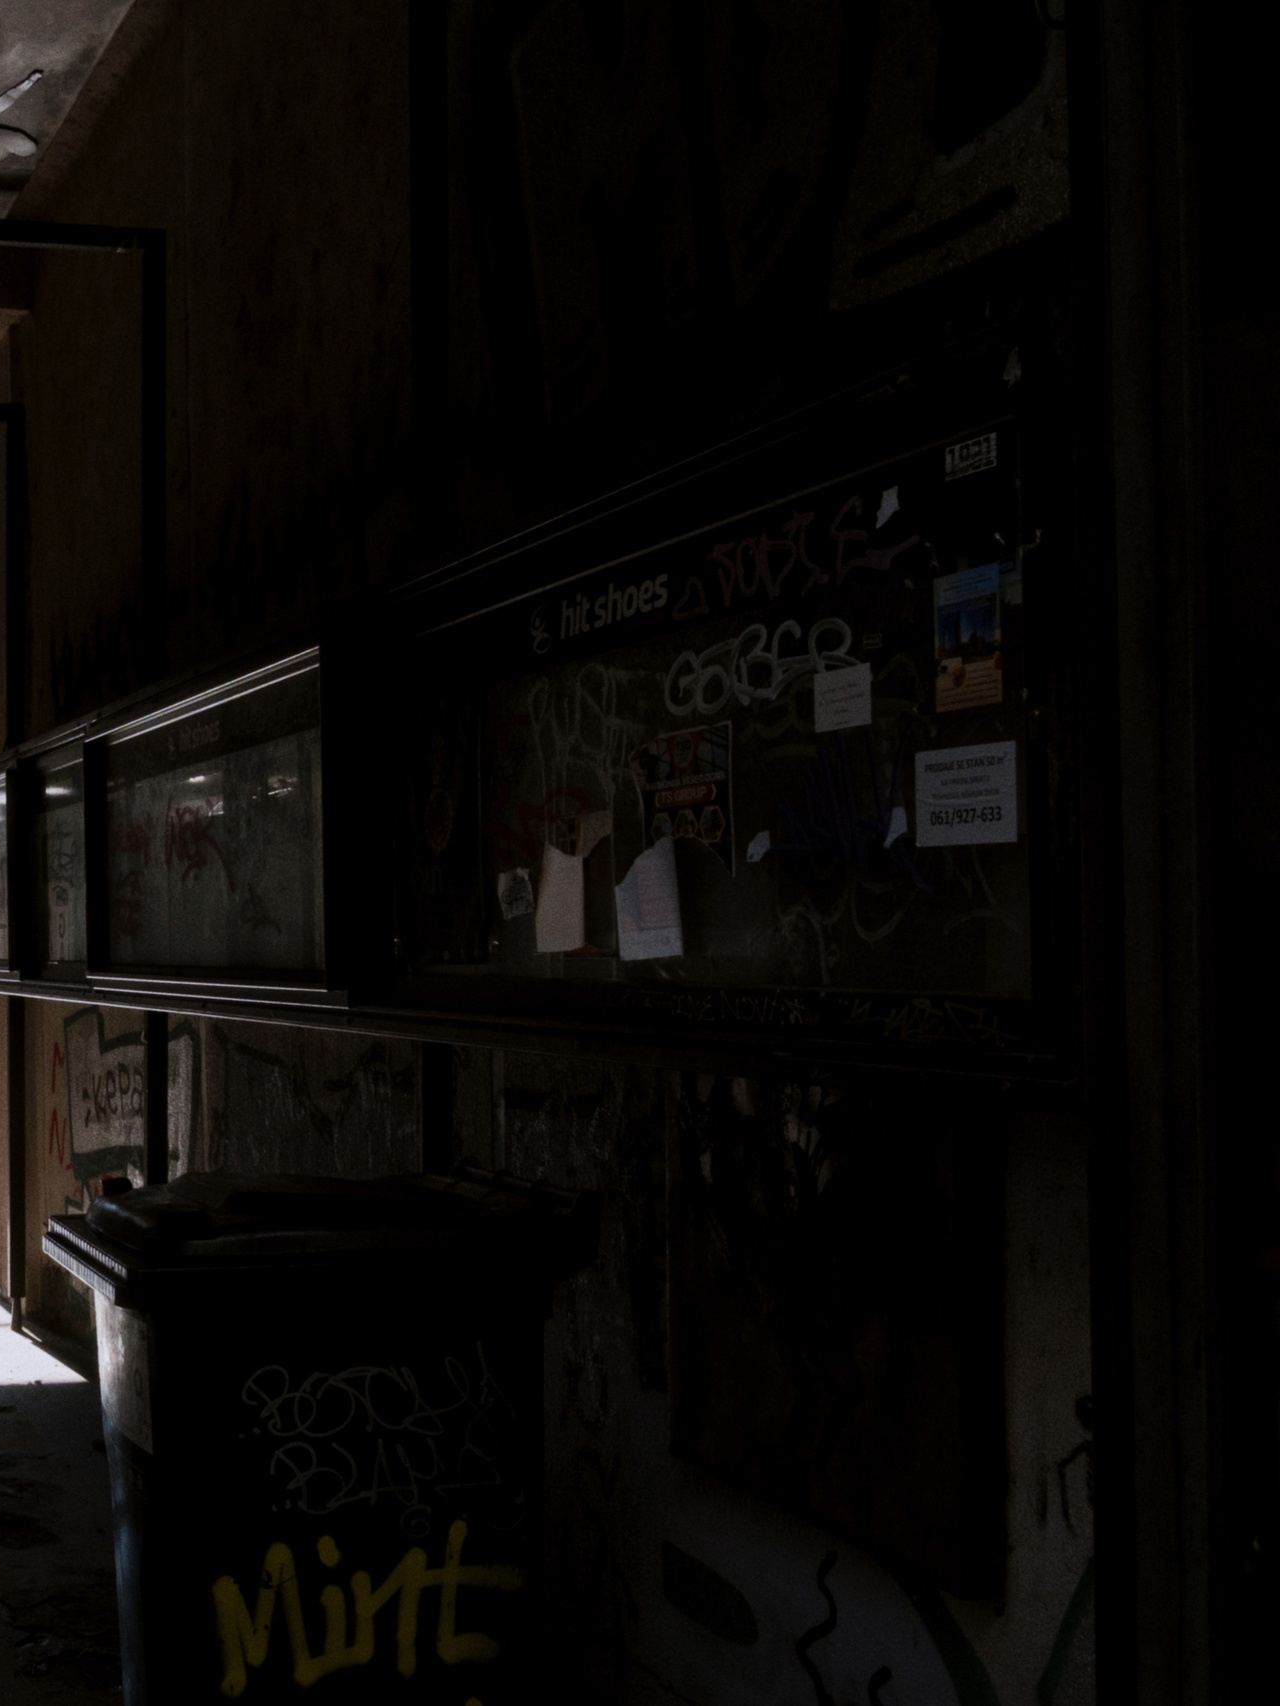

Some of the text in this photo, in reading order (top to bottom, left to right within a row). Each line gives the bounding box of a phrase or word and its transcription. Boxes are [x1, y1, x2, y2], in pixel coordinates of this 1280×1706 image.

[560, 593, 590, 640] hit
[593, 573, 669, 629] shoes
[924, 760, 955, 773] PRODAJE
[956, 759, 965, 770] SE
[965, 757, 985, 769] STAN
[674, 785, 707, 802] GROUP
[930, 806, 1002, 828] 061/927-633
